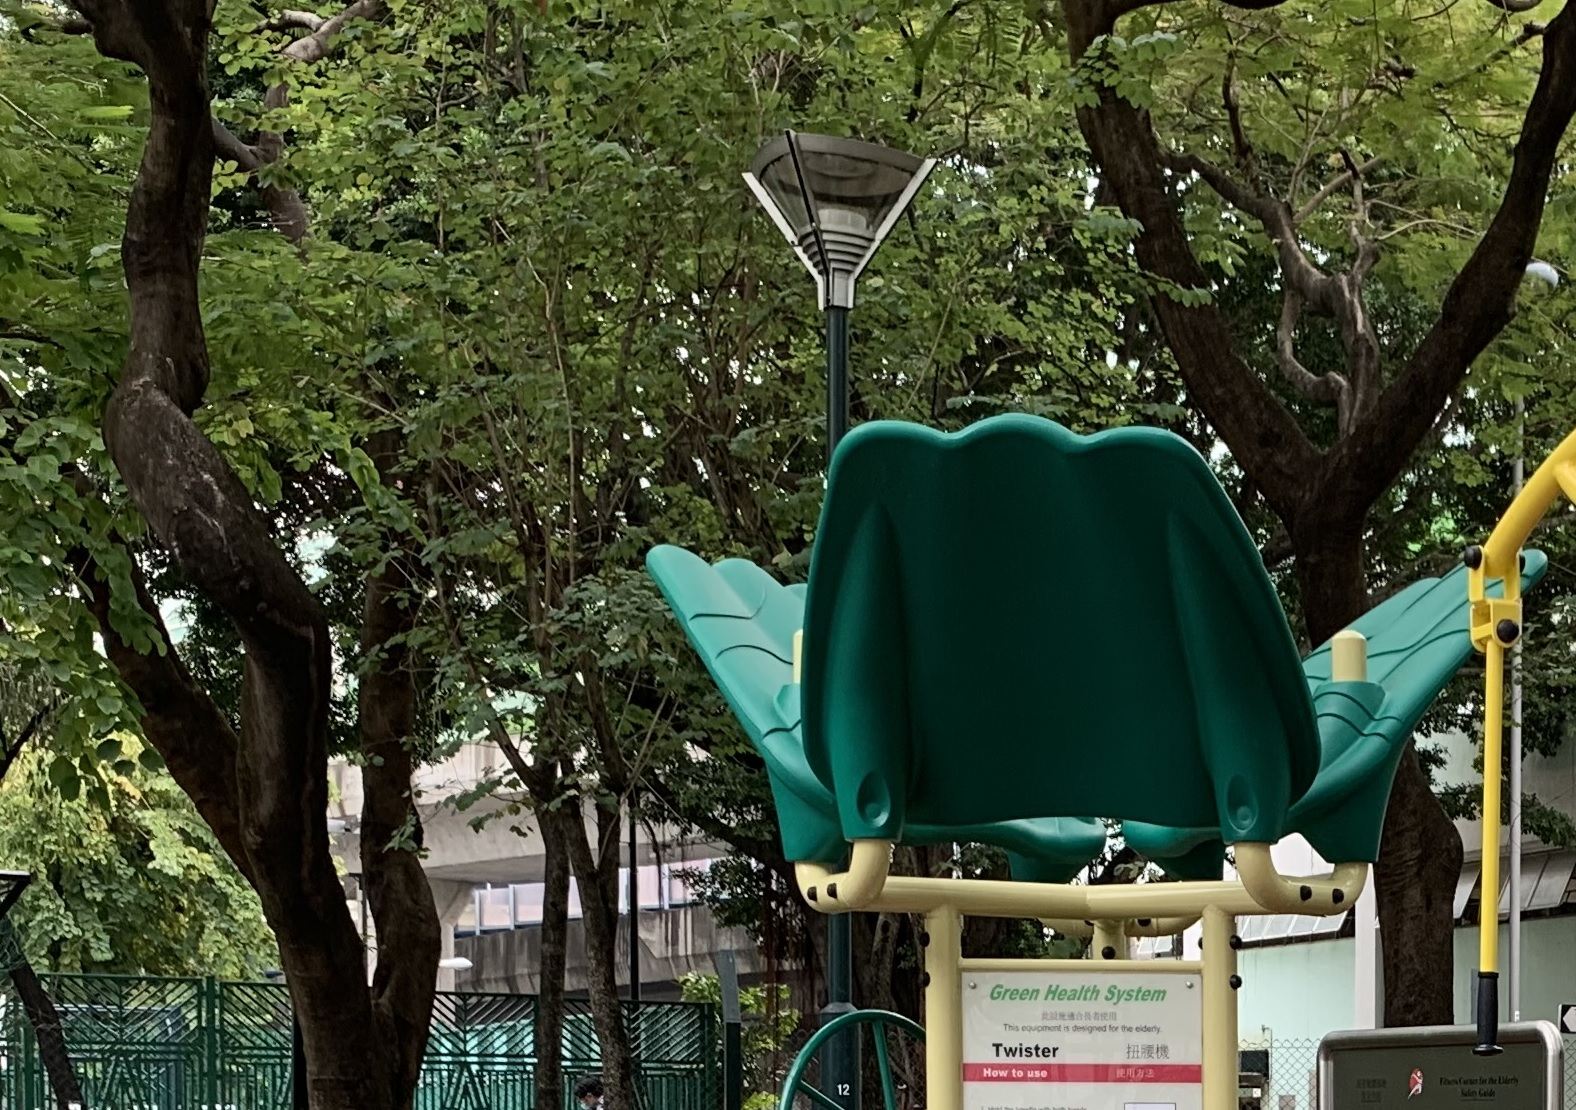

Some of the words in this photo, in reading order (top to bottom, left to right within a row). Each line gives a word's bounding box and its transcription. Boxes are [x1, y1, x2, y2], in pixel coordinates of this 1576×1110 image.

[989, 983, 1040, 1001] Green
[1044, 984, 1101, 1002] Health
[1104, 985, 1167, 1005] System
[1003, 1024, 1020, 1032] This
[1022, 1024, 1062, 1034] equipment
[1072, 1024, 1106, 1034] designed
[1108, 1024, 1119, 1032] for
[1120, 1024, 1134, 1032] the
[992, 1042, 1059, 1058] Twister
[983, 1067, 1008, 1078] How
[1012, 1067, 1024, 1078] to
[1027, 1069, 1048, 1078] use
[1116, 1068, 1154, 1079] 使用方法
[837, 1083, 850, 1096] 12
